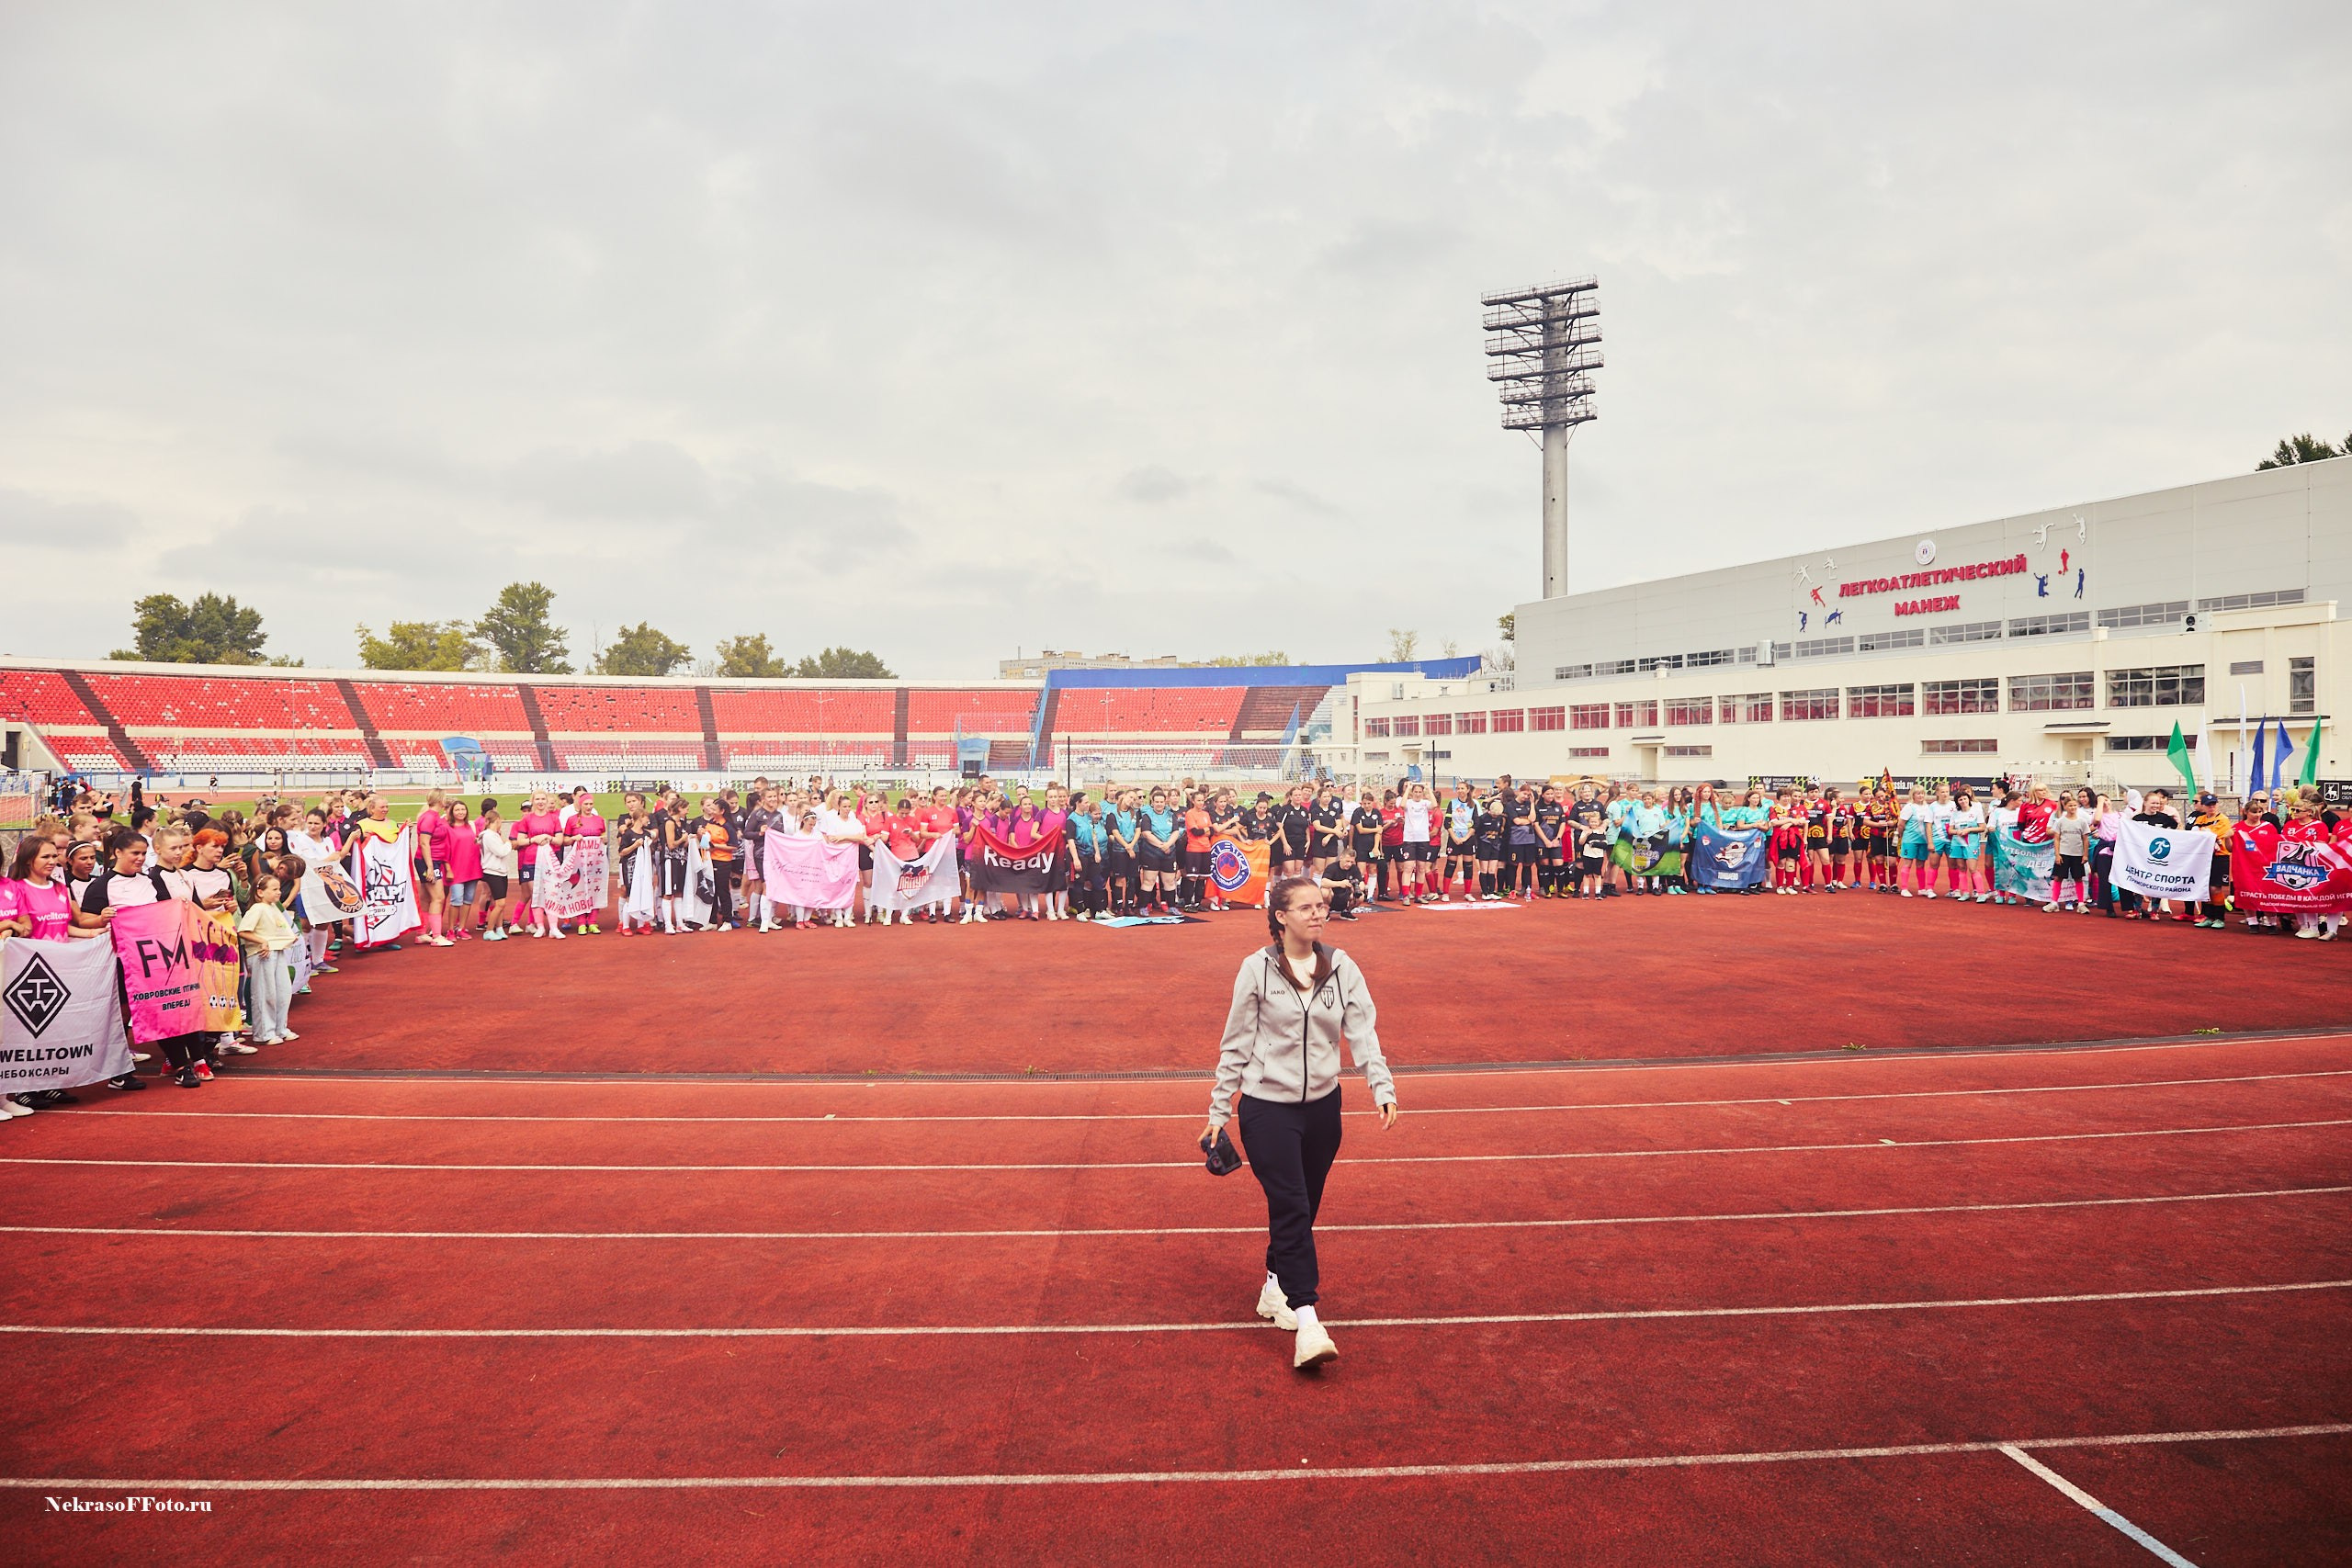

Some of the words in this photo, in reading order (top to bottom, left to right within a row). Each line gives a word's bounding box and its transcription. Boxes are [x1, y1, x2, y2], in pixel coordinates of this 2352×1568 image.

[1839, 553, 2027, 597] ЛЕГКОАТЛЕТИЧЕСКИЙ
[1894, 594, 1961, 616] МАНЕЖ
[983, 845, 1056, 874] Ready
[2125, 863, 2153, 880] ЦЕНТР
[2276, 864, 2320, 876] ВАДЧАНКА
[2154, 874, 2195, 885] СПОРТА
[2240, 891, 2267, 899] СТРАСТЬ
[2267, 893, 2296, 901] ПОБЕДЫ
[133, 987, 181, 1001] КОВРОВСКИЕ
[0, 1043, 93, 1063] WELLTOWN
